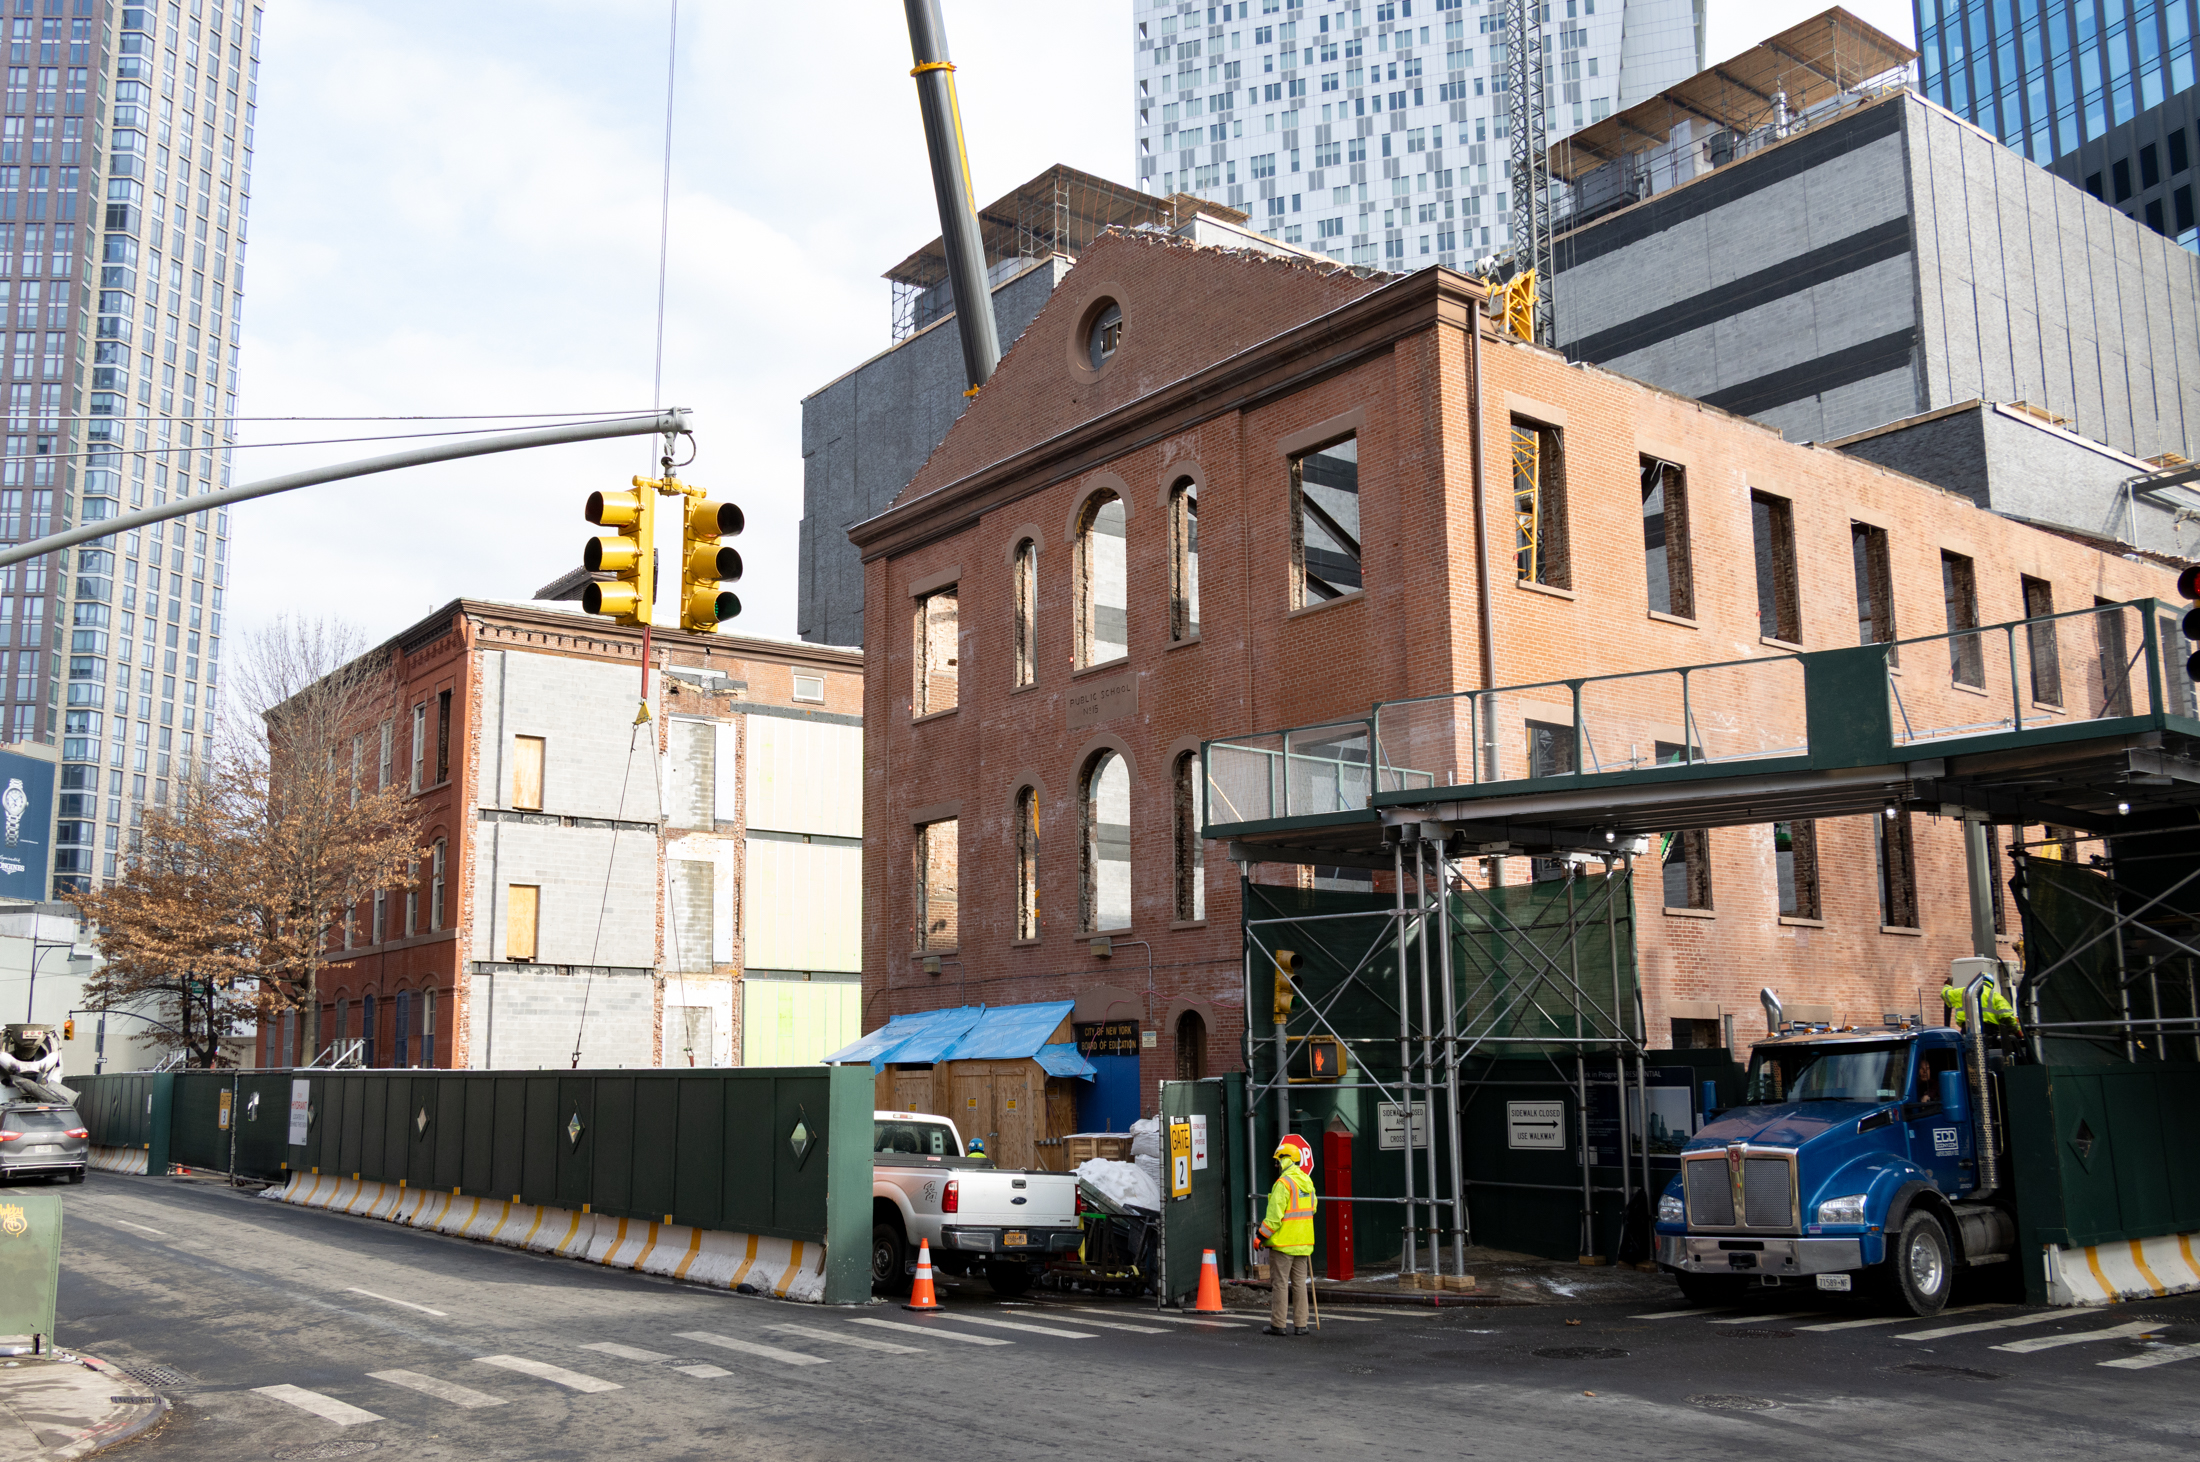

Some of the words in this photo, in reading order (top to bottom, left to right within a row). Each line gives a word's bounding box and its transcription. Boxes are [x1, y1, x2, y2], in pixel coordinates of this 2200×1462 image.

[1070, 692, 1097, 708] PUBLIC
[1101, 684, 1131, 699] SCHOOL
[1084, 1027, 1095, 1036] CITY
[1096, 1026, 1104, 1036] OF
[1106, 1026, 1117, 1036] NEW
[1118, 1026, 1132, 1035] YORK
[1100, 1041, 1107, 1050] OF
[1108, 1040, 1136, 1050] EDUCATION
[1599, 1071, 1618, 1079] Progre
[1172, 1129, 1190, 1150] GATE
[1180, 1160, 1184, 1185] 2
[979, 1215, 1016, 1223] SUPER
